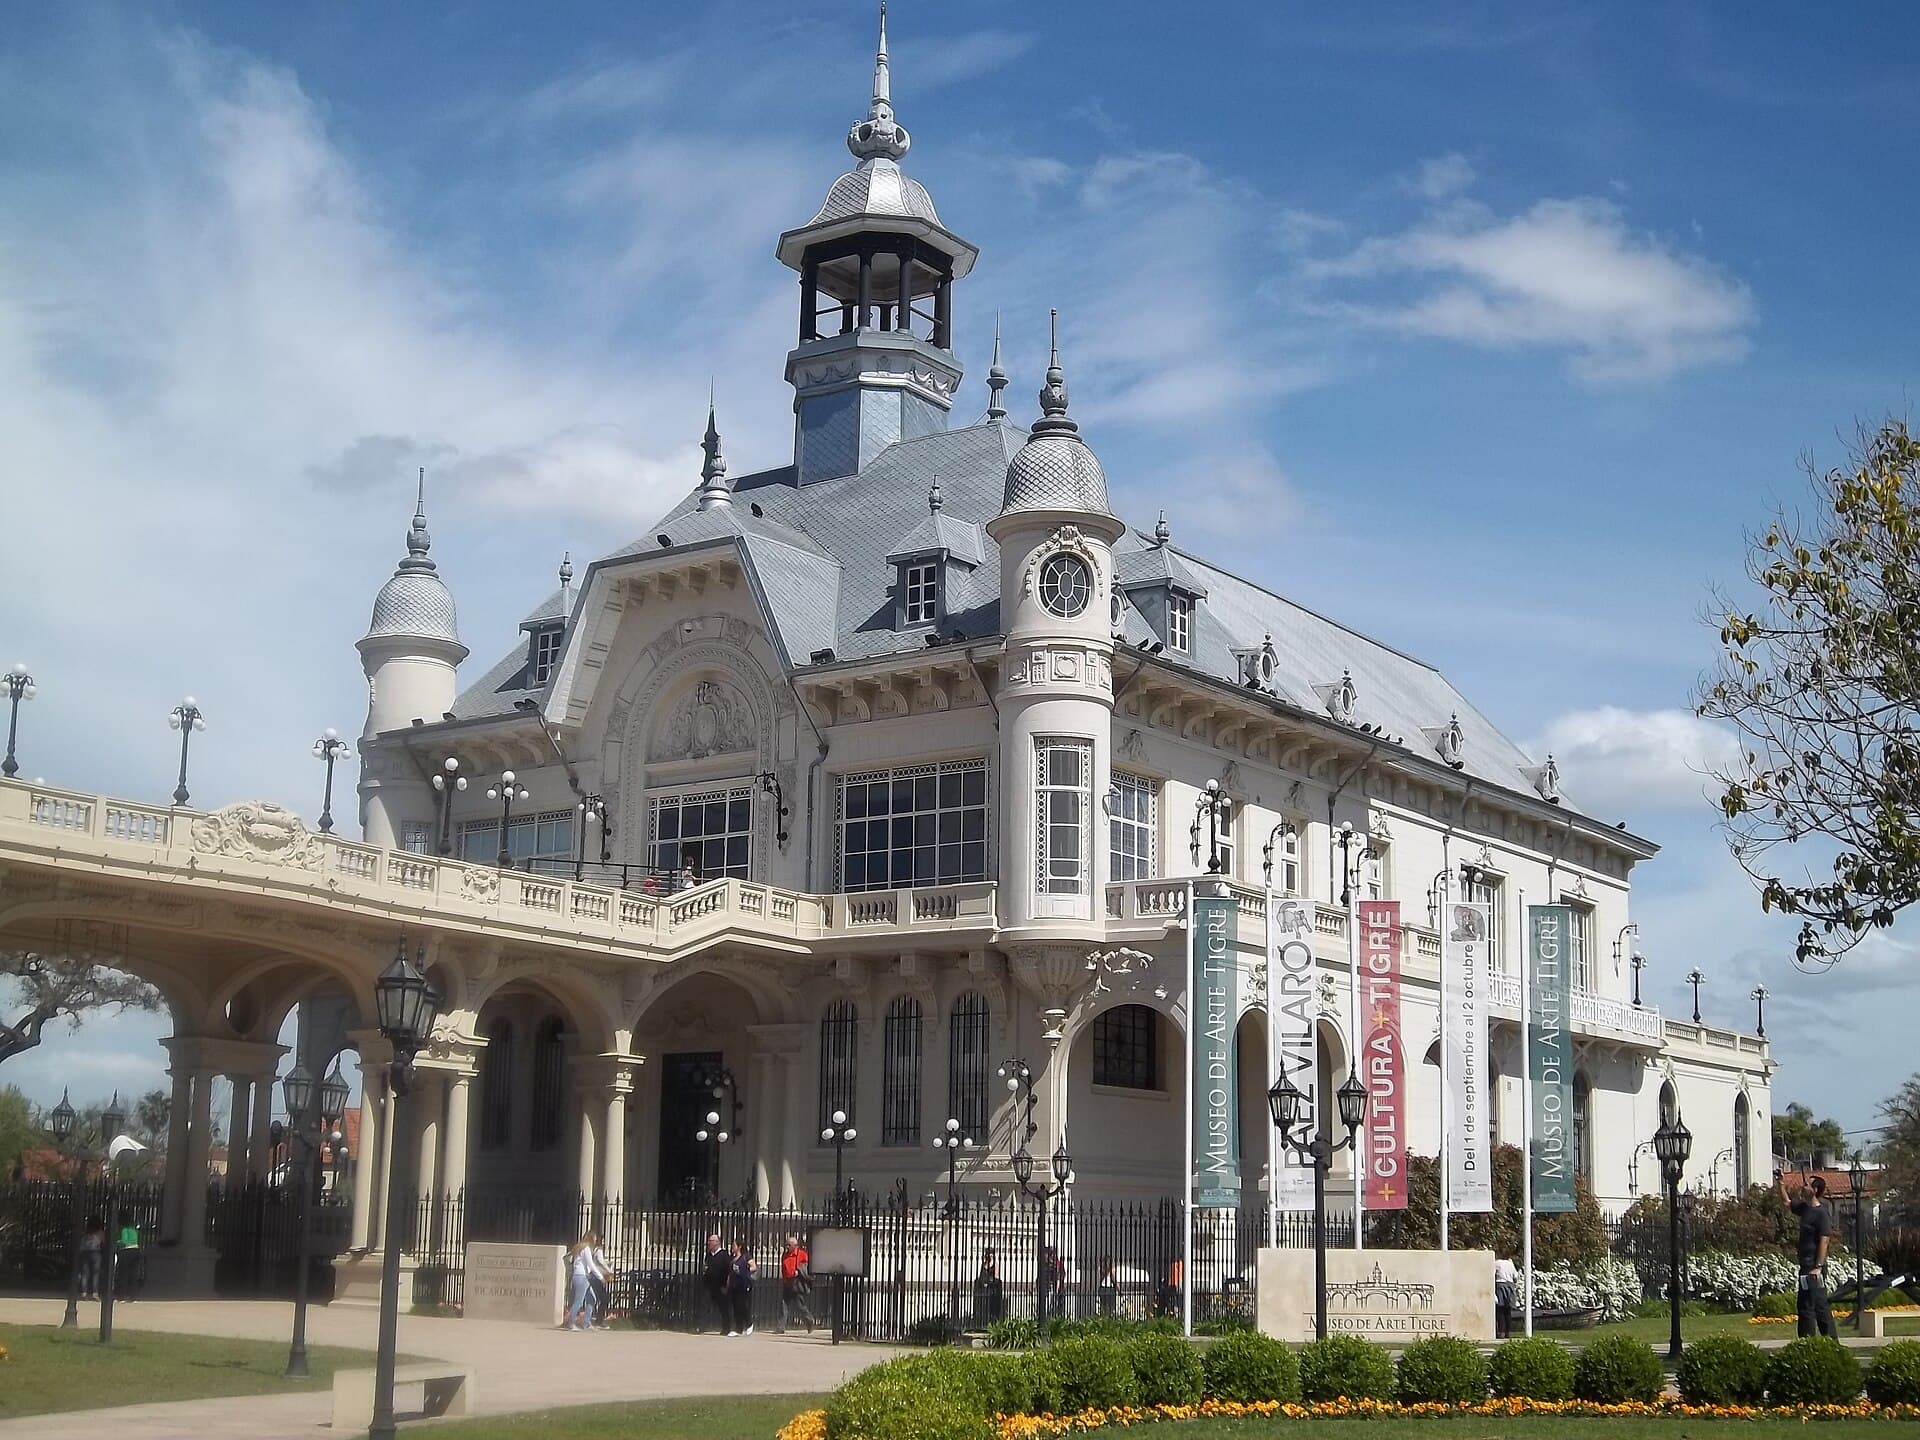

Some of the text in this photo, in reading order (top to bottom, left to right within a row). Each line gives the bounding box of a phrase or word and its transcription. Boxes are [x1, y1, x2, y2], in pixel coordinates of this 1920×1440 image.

[1463, 944, 1474, 998] octubre
[1463, 1002, 1474, 1010] 2
[1463, 1014, 1474, 1027] al
[1203, 909, 1228, 1174] MUSEO DE ARTE TIGRE
[1537, 915, 1563, 1179] MUSEO DE ARTE TIGRE
[1463, 1031, 1476, 1110] septiembre
[1464, 1116, 1475, 1133] de
[1464, 1149, 1475, 1171] Del
[1356, 1318, 1371, 1330] DE
[1375, 1316, 1406, 1330] ARTE
[1408, 1316, 1446, 1330] TIGRE
